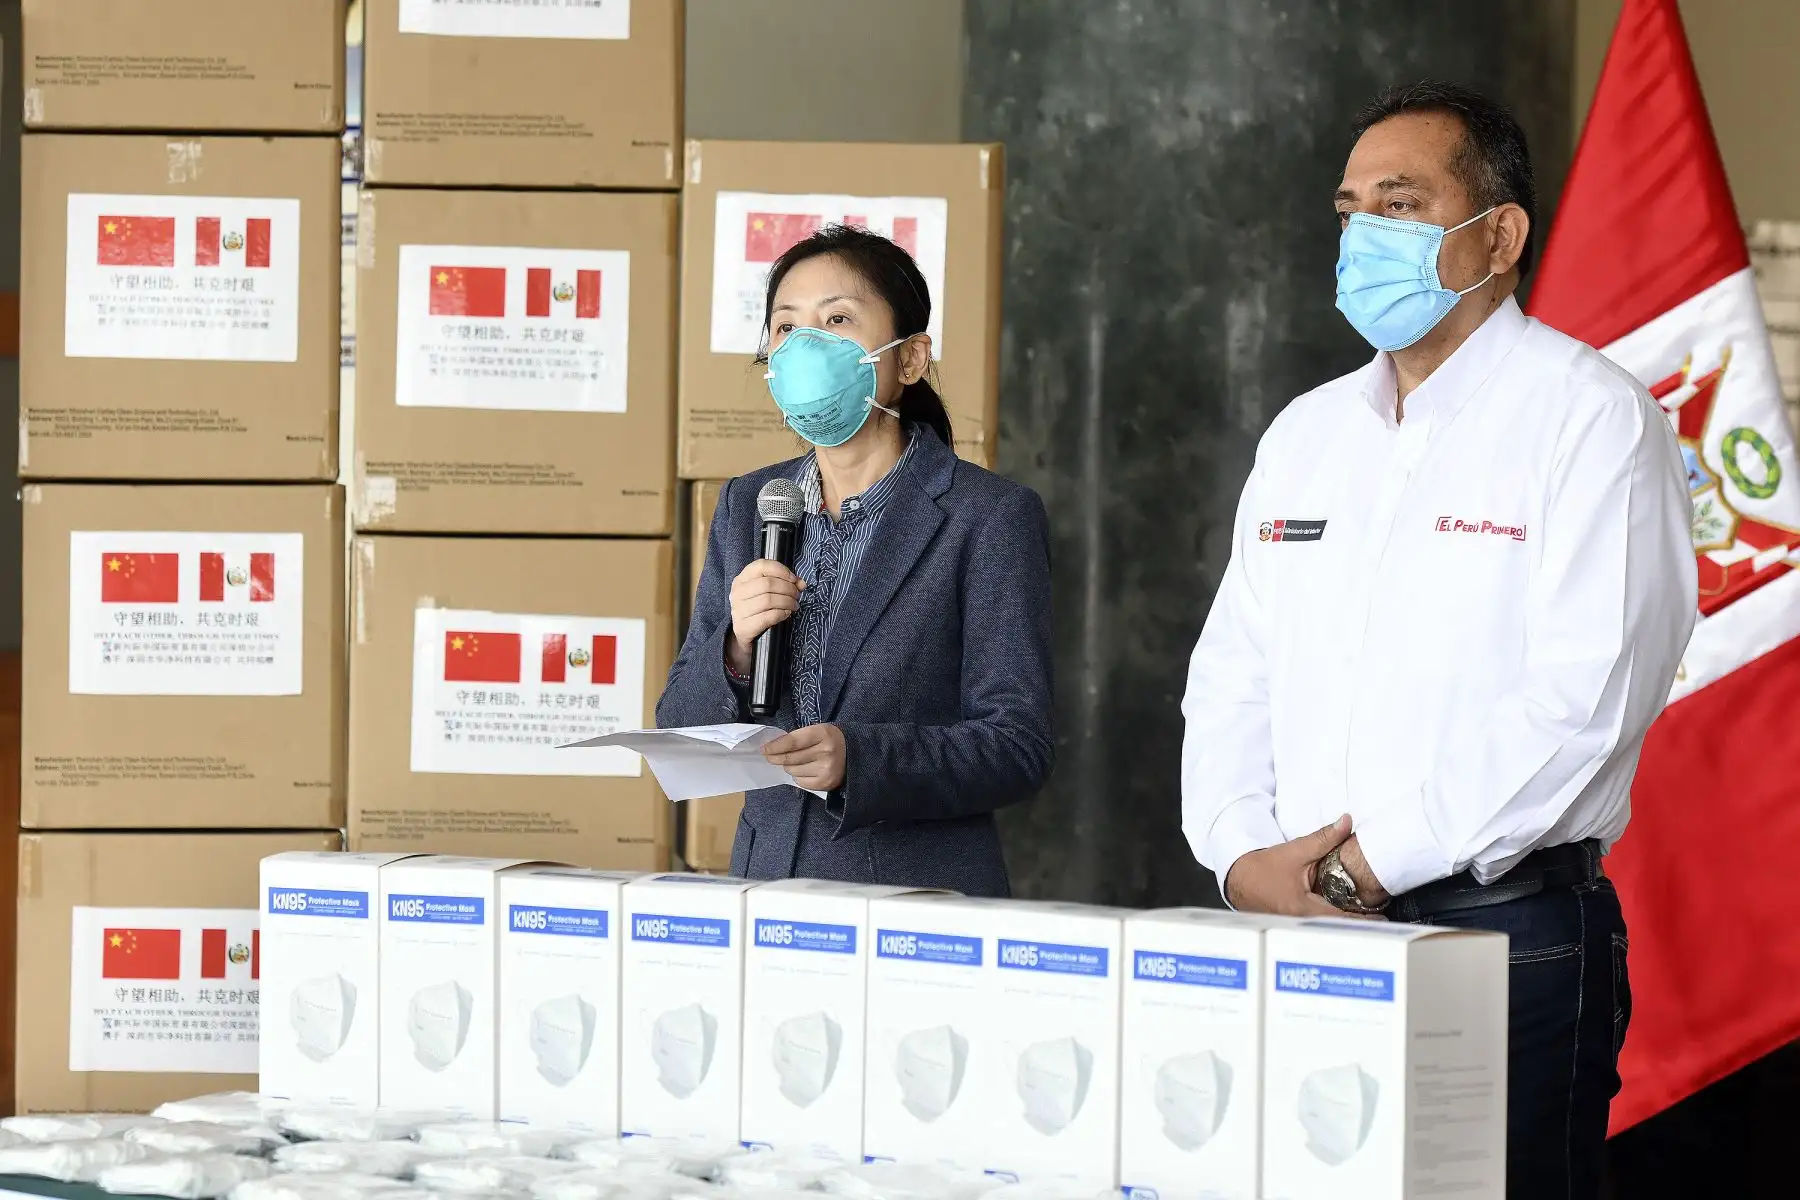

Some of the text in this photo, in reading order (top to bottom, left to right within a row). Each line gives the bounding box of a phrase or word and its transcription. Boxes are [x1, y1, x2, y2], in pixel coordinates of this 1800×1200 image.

[273, 892, 360, 910] KN95 Protective Mask
[392, 899, 424, 918] KN95
[425, 903, 457, 913] Protective
[459, 904, 476, 913] Mask
[513, 910, 547, 929] KN95
[548, 915, 580, 926] Protective
[636, 919, 668, 938] KN95
[669, 923, 702, 934] Protective
[758, 923, 793, 944] KN95
[794, 930, 828, 941] Protective
[881, 935, 917, 956] KN95
[917, 941, 953, 953] Protective
[1001, 944, 1039, 967] KN95
[1137, 955, 1176, 979] KN95
[1279, 967, 1321, 990] KN95
